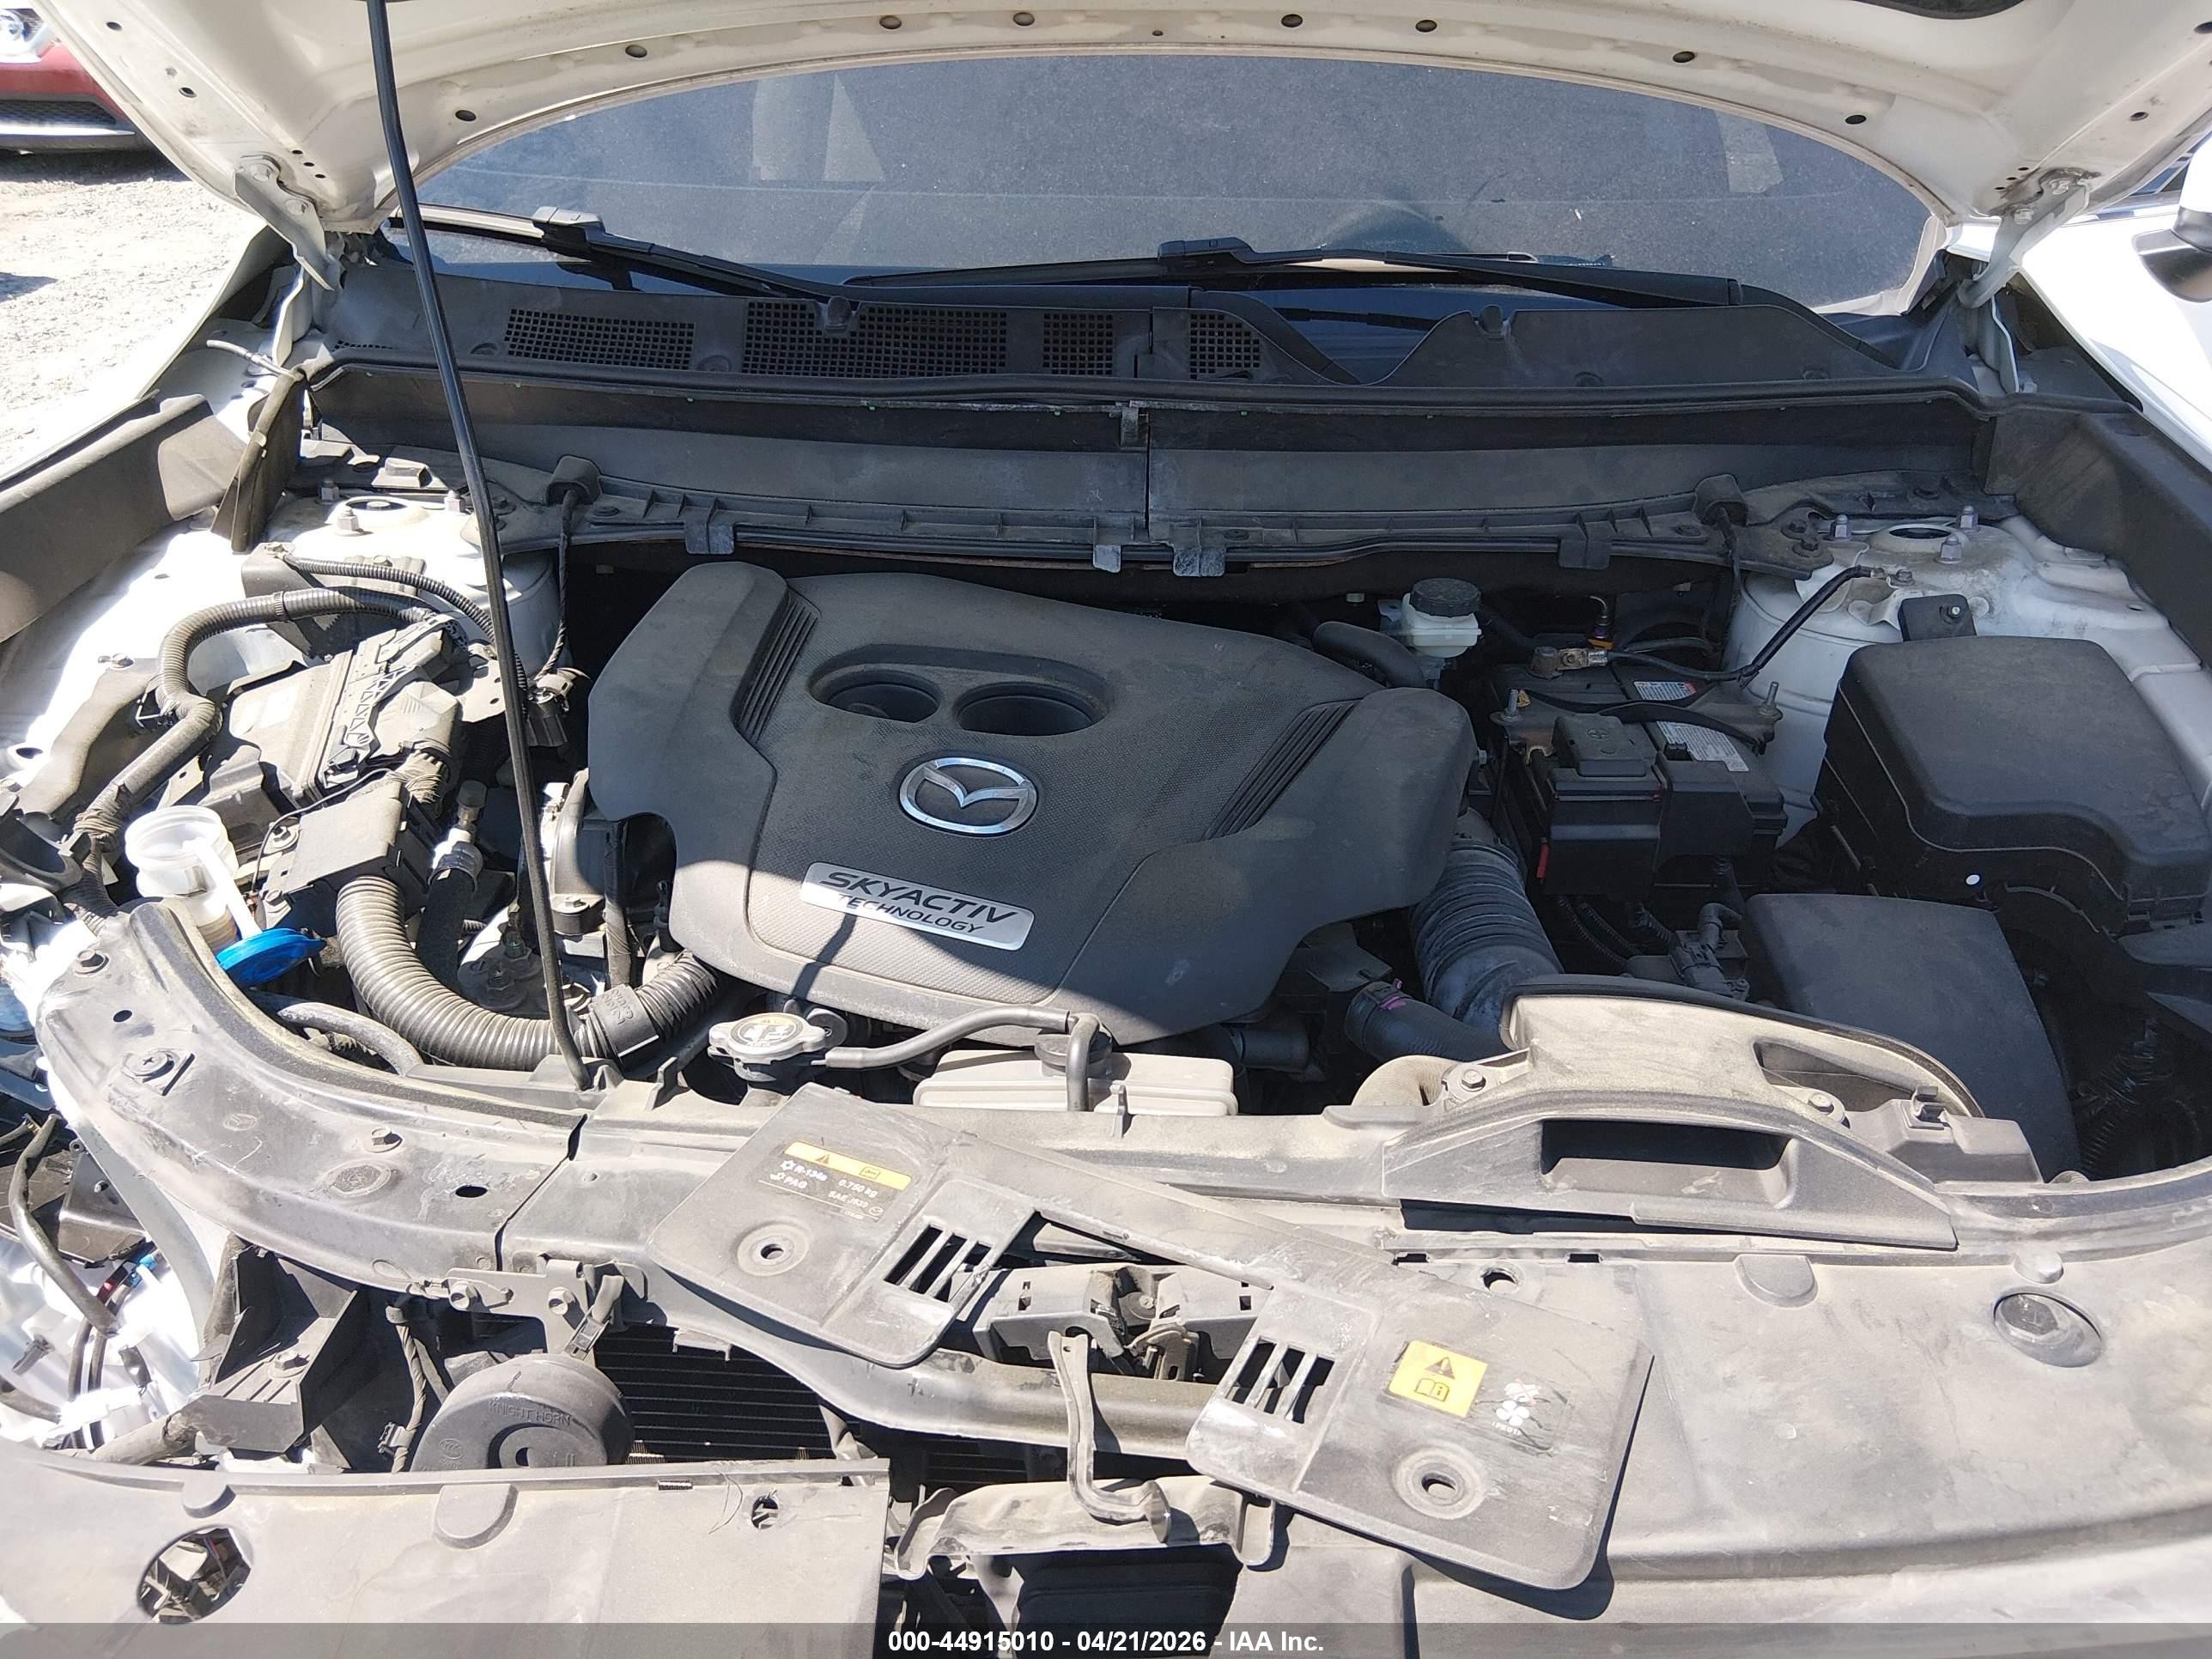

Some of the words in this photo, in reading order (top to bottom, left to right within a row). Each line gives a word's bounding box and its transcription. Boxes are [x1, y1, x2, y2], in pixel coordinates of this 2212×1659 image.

[819, 872, 1018, 923] SKYACTIV
[837, 894, 985, 933] TECHNOLOGY
[536, 1411, 571, 1427] HORN
